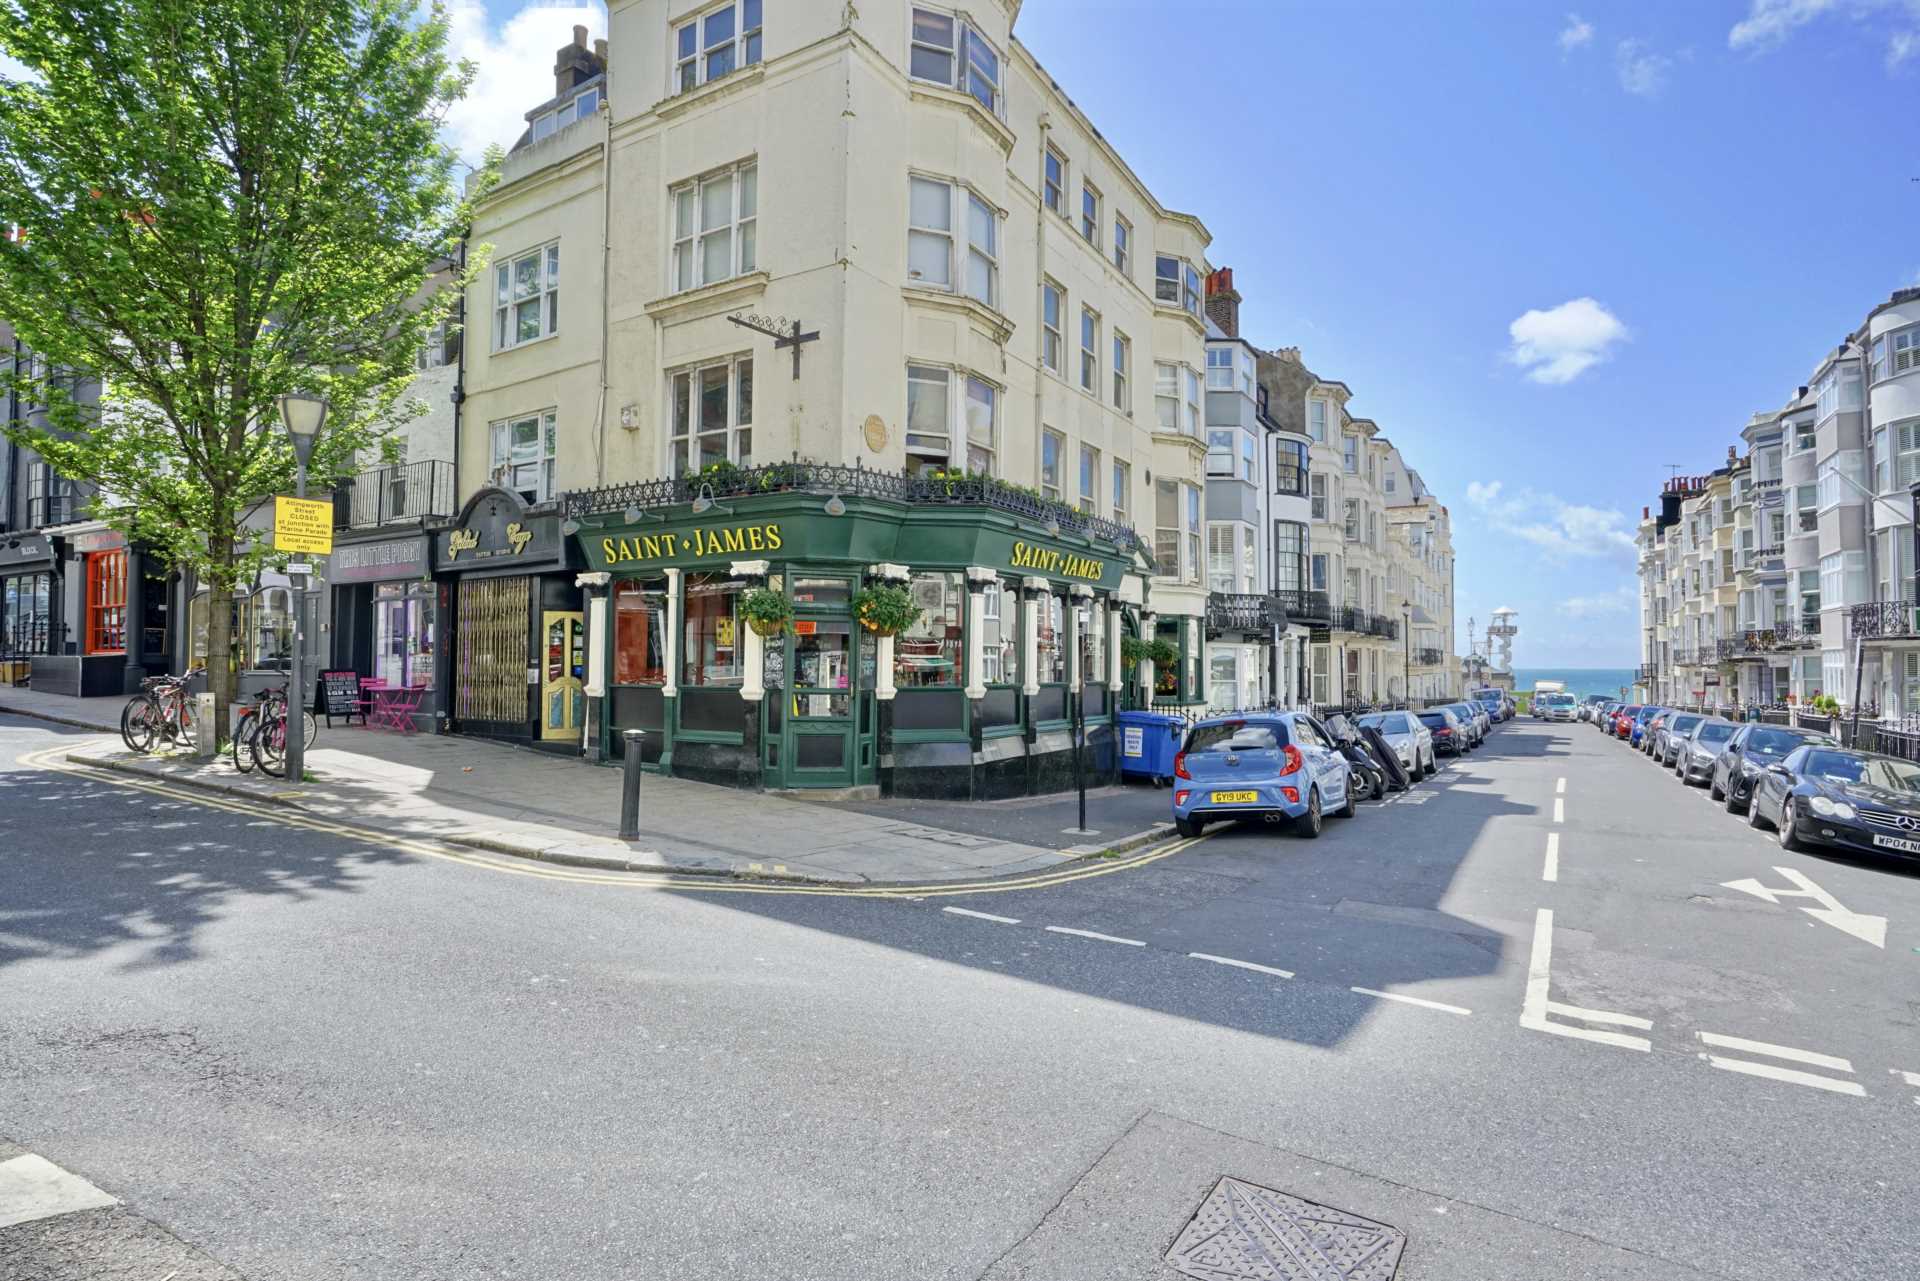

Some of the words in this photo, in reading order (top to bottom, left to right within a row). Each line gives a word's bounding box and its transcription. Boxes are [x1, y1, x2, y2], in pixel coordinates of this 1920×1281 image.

[290, 513, 319, 521] CLOSED
[287, 520, 314, 528] junction
[602, 534, 676, 564] SAINT
[693, 524, 782, 557] JAMES
[1011, 542, 1060, 572] SAINT
[1063, 553, 1104, 580] JAMES
[1216, 792, 1236, 801] GY19
[1236, 792, 1252, 801] UKC
[1878, 836, 1907, 849] WP04
